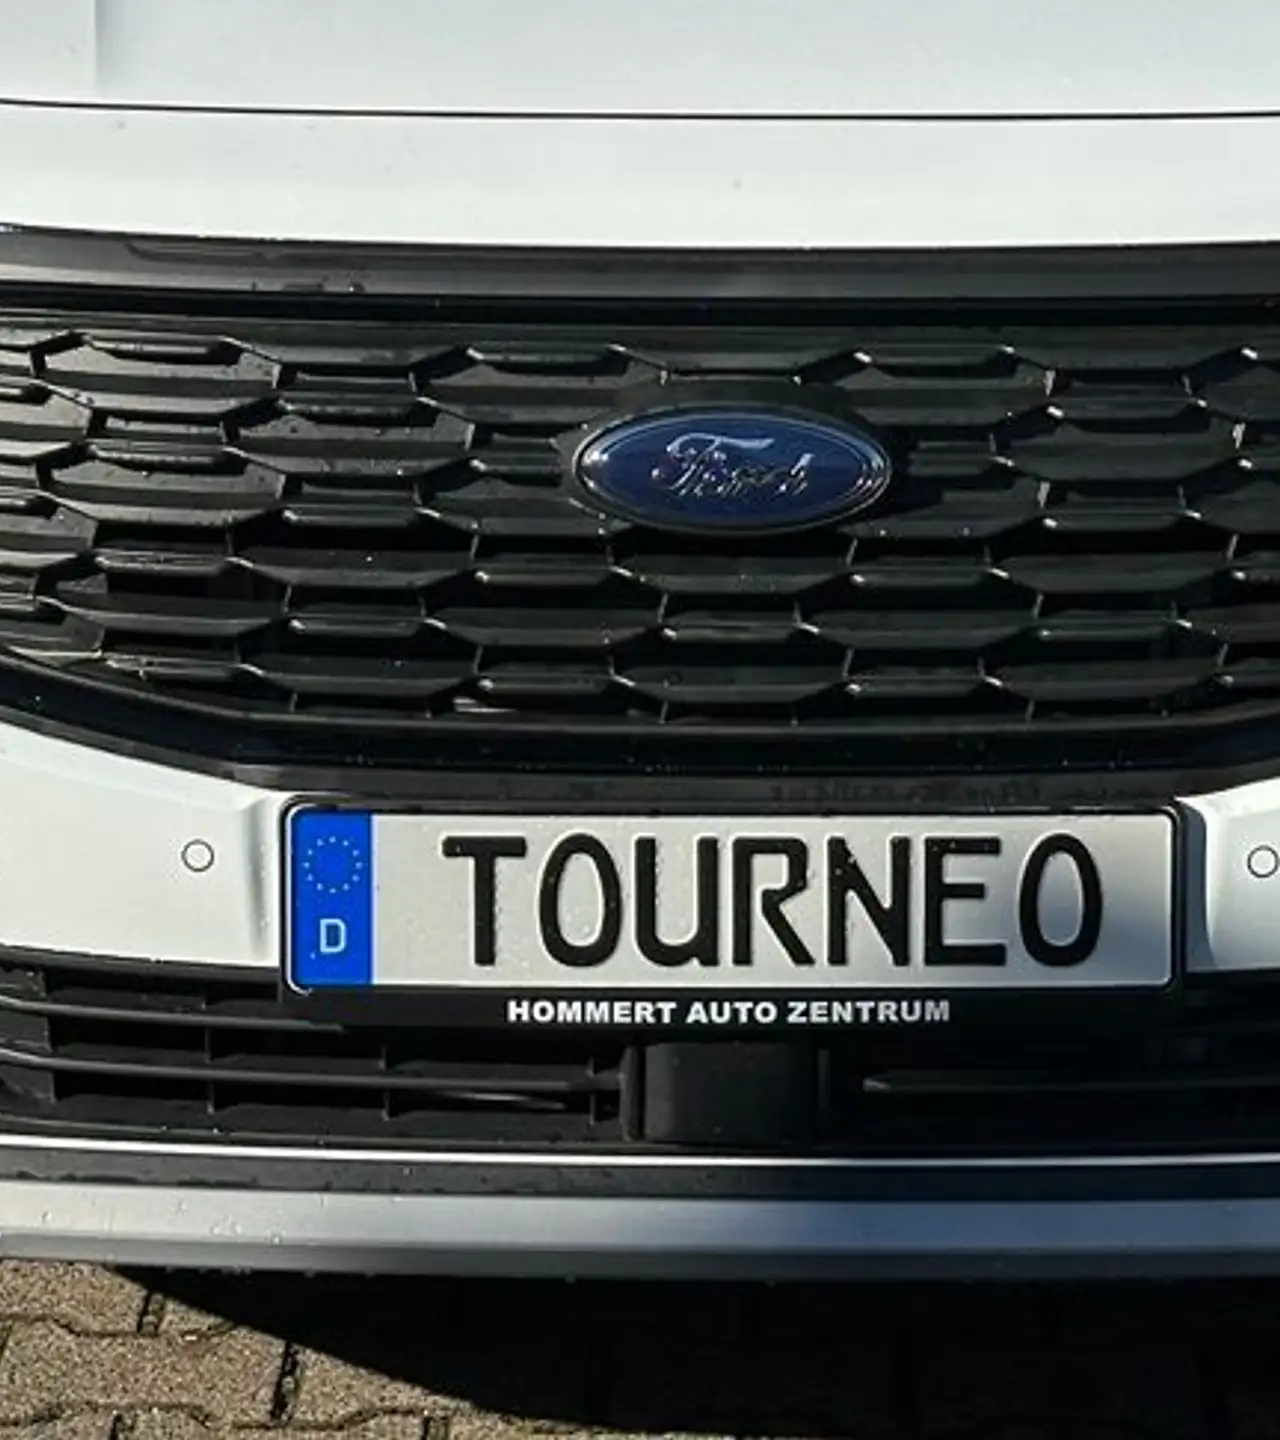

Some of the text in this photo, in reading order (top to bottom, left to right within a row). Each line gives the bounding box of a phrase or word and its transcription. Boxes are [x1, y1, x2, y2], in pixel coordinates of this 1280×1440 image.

[319, 832, 1104, 969] D TOURNEO
[506, 998, 950, 1025] HOMMERT AUTO ZENTRUM
